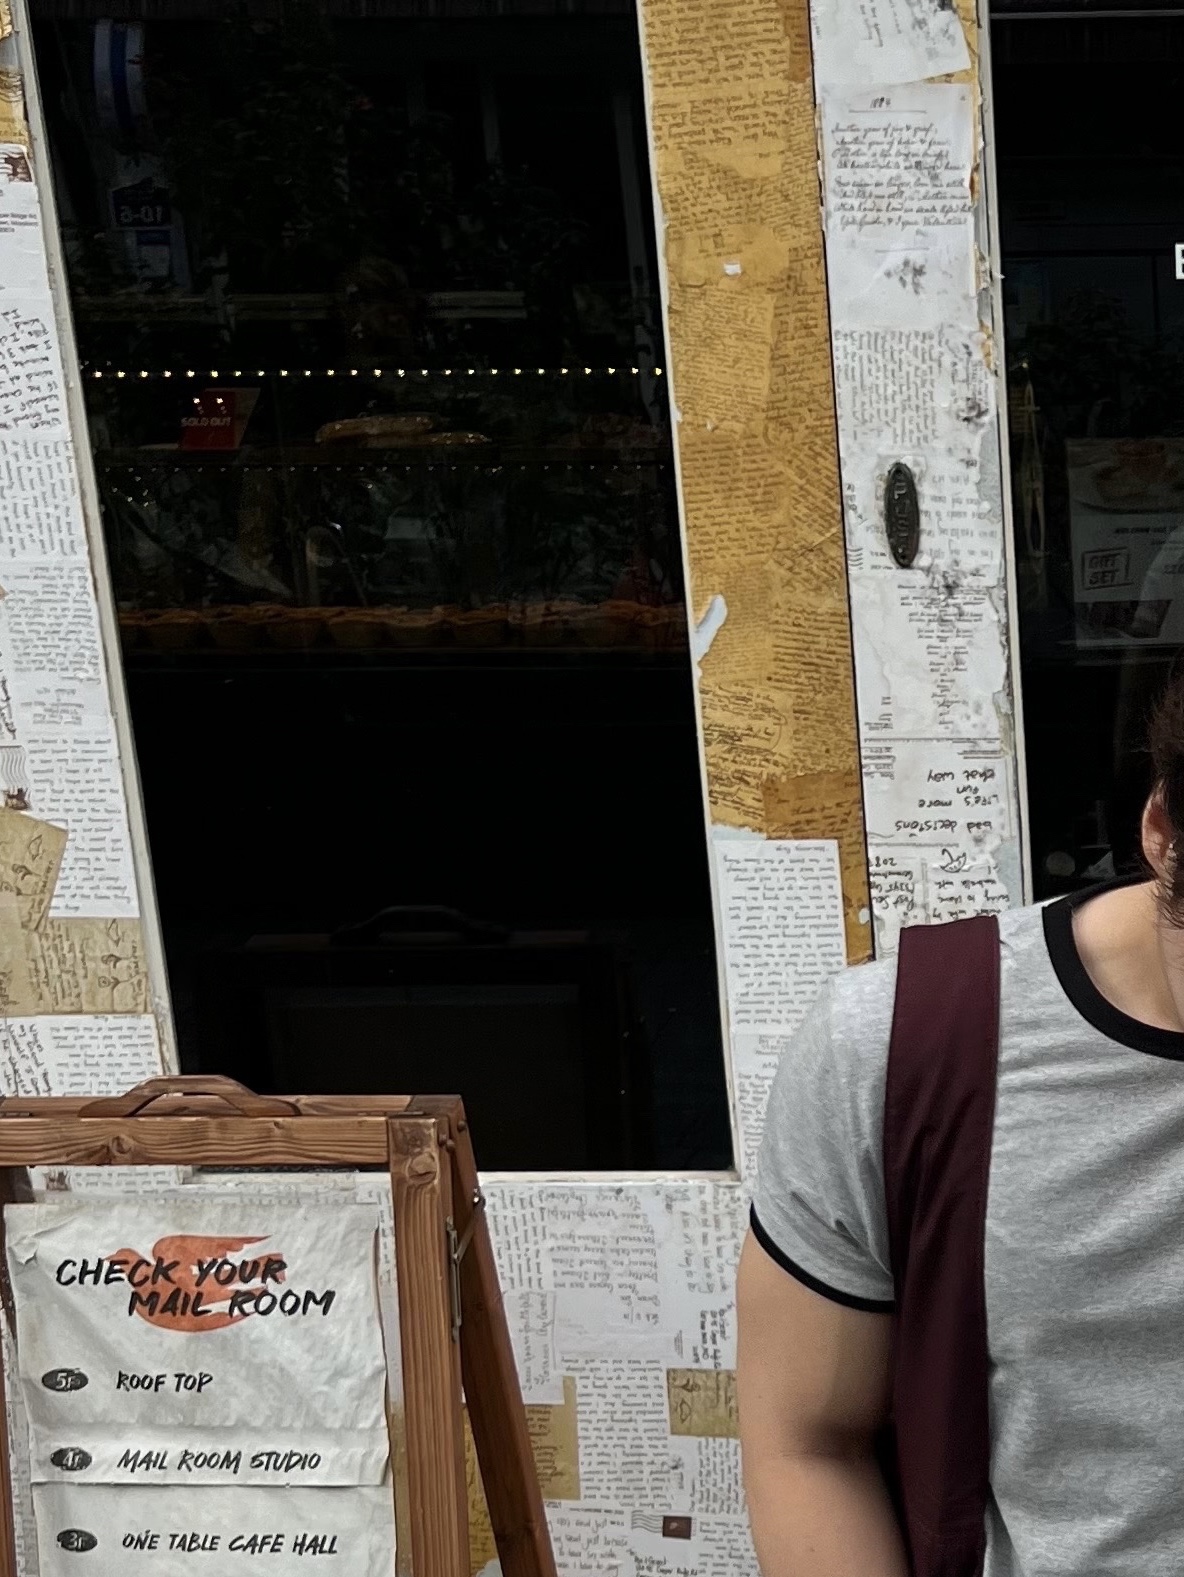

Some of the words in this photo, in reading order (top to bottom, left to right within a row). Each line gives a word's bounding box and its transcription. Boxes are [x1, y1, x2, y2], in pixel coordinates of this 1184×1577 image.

[56, 1257, 181, 1286] CHECK
[195, 1257, 288, 1287] YOUR
[128, 1288, 212, 1317] MAIL
[228, 1288, 336, 1317] ROOM
[116, 1370, 168, 1392] ROOF
[174, 1371, 213, 1393] TOP
[117, 1448, 169, 1474] MAIL
[177, 1448, 243, 1475] ROOM
[250, 1450, 322, 1473] STUDIO
[122, 1530, 161, 1551] ONE
[168, 1532, 222, 1551] TABLE
[228, 1532, 285, 1554] CAFE
[292, 1533, 338, 1556] HALL
